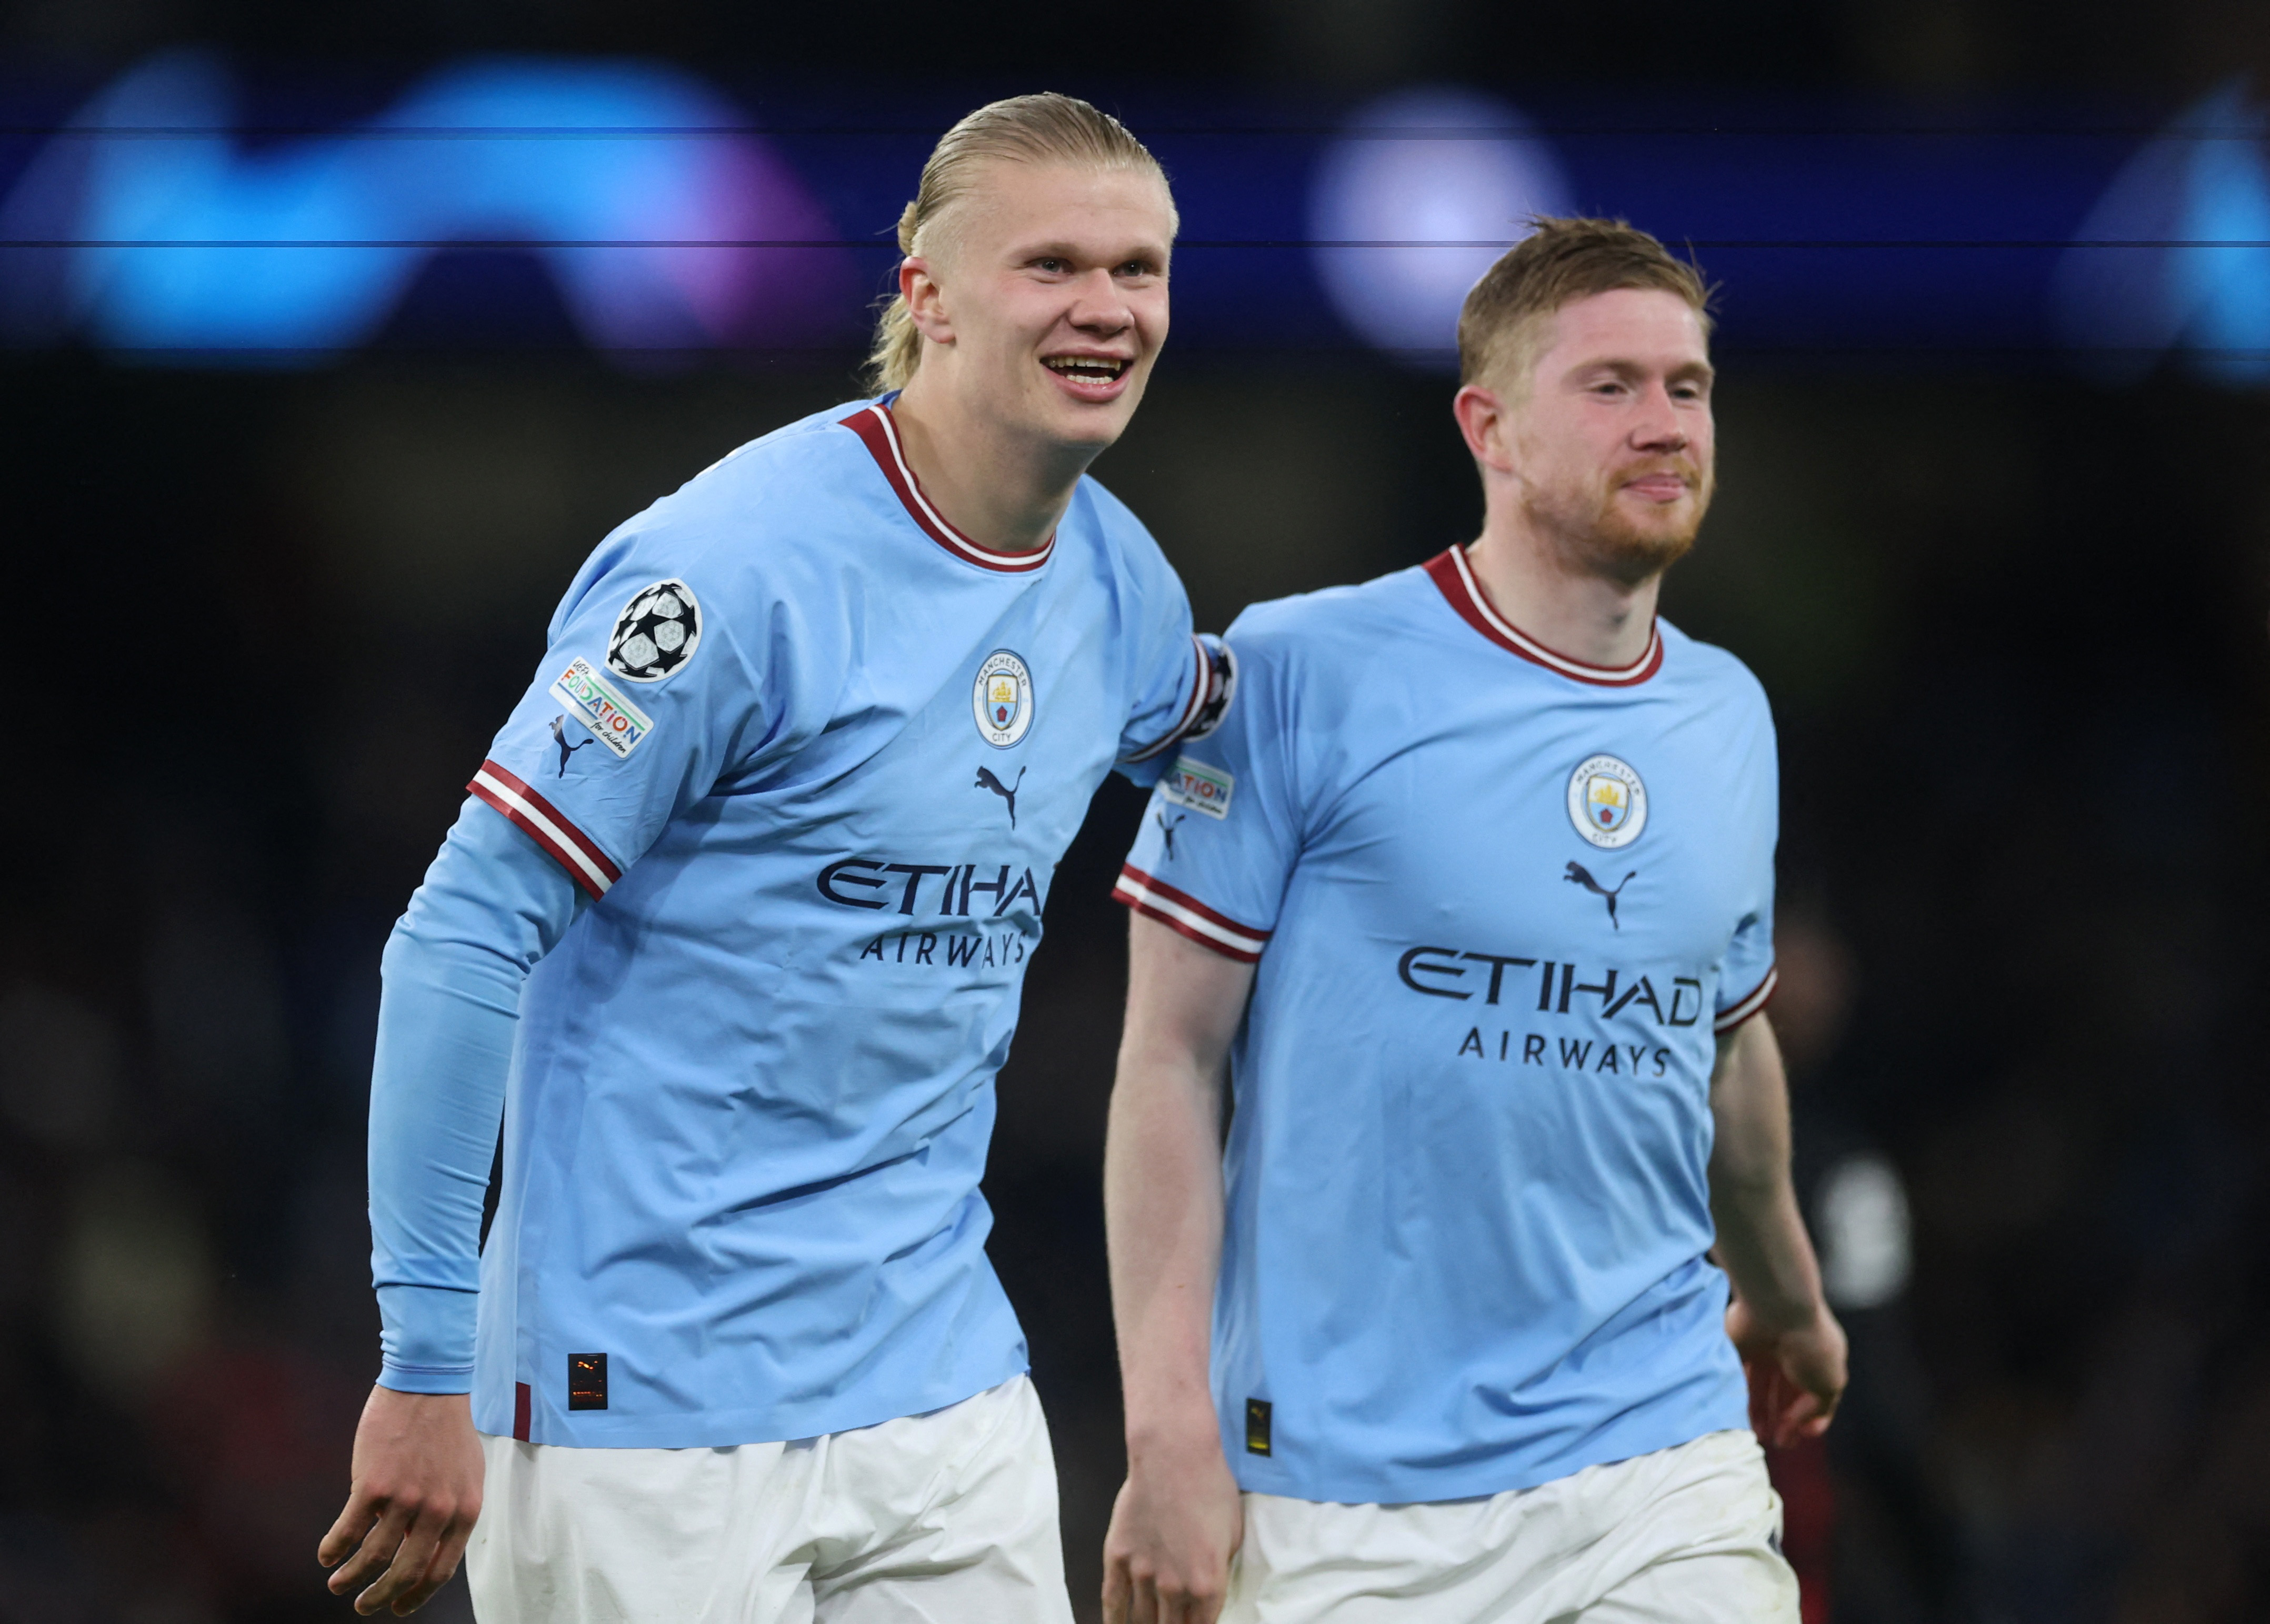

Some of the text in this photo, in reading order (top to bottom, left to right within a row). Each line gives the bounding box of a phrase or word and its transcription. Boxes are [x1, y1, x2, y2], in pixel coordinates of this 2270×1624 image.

[573, 660, 589, 676] UEFA
[978, 658, 1026, 687] MANCHESTER
[561, 669, 642, 744] FOUDATION
[590, 721, 626, 754] for children
[992, 733, 1011, 742] CITY
[817, 859, 1041, 916] ETIHA
[859, 931, 1027, 969] AIRWAYS
[1398, 946, 1703, 1026] ETIHAD
[1457, 1026, 1670, 1077] AIRWAYS
